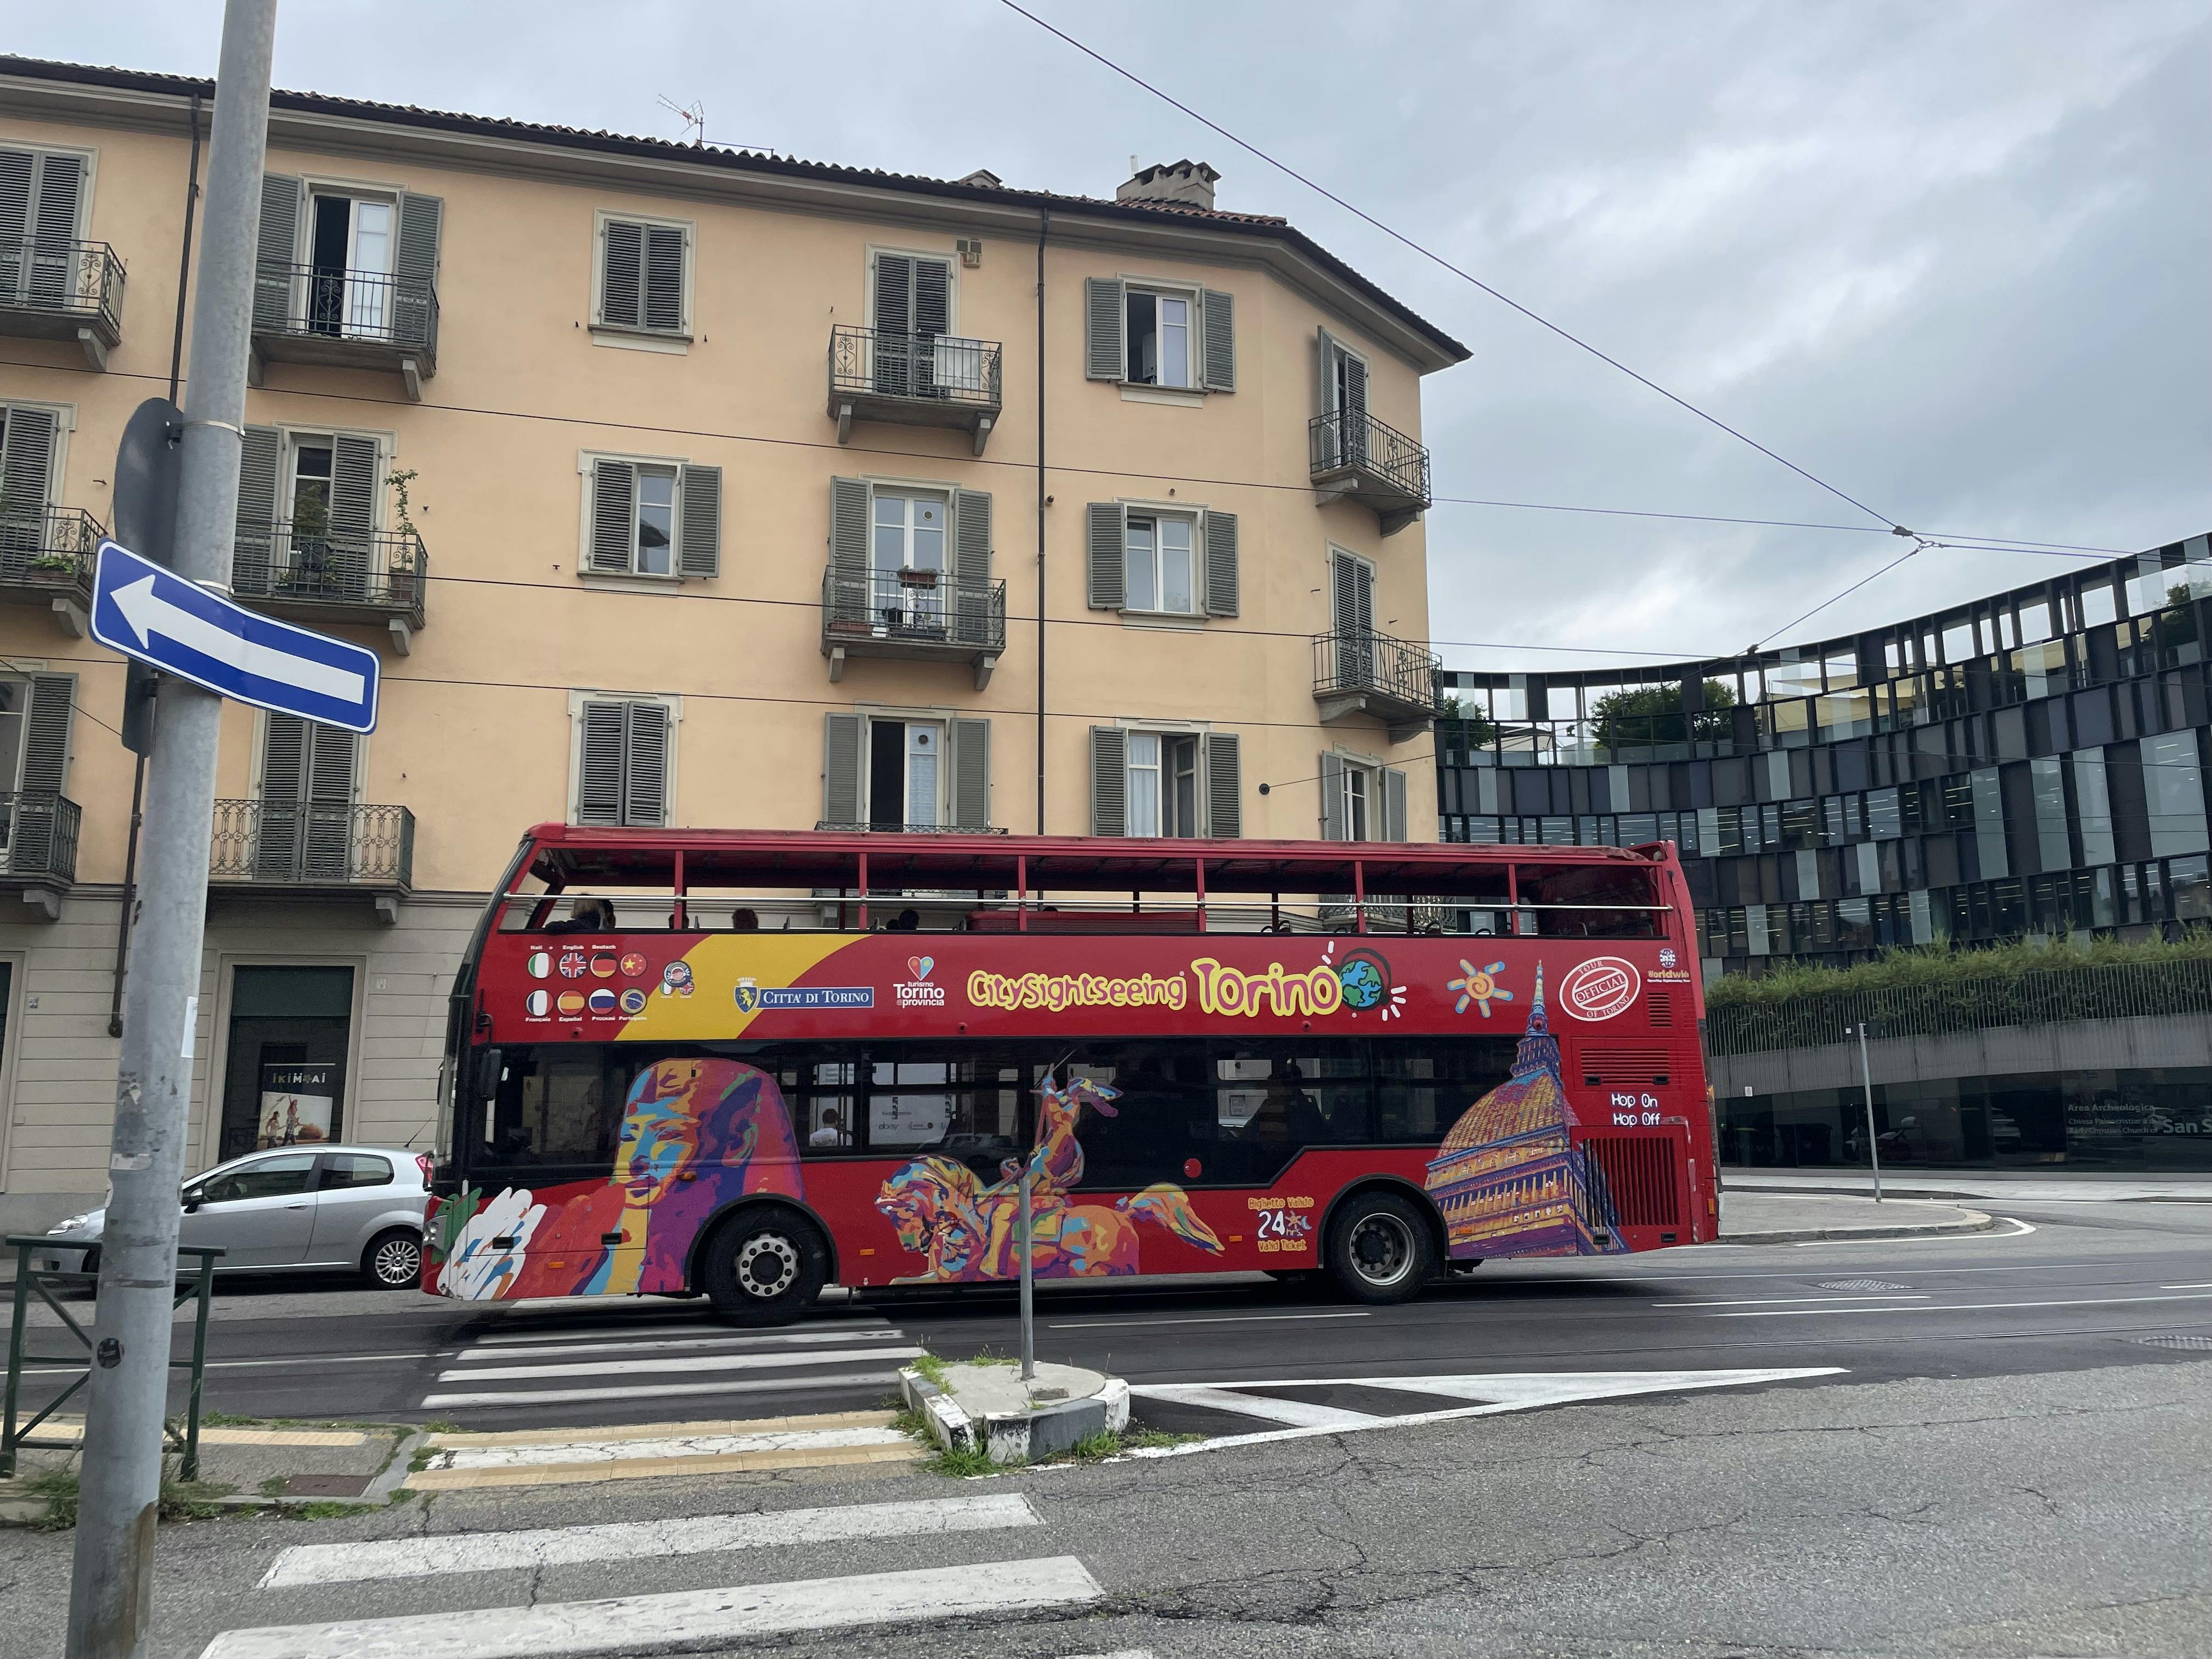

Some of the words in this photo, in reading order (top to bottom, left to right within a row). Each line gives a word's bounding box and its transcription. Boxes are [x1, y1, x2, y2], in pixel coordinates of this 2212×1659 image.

[1577, 960, 1604, 975] TOUR
[893, 984, 945, 999] Torino
[1191, 957, 1343, 1018] Torino
[1576, 975, 1626, 1002] OFFICIAL
[806, 993, 819, 1003] DI
[822, 990, 869, 1003] TORINO
[902, 999, 945, 1009] provincia
[1601, 995, 1630, 1016] TORINO
[1611, 1093, 1635, 1108] Hop
[1641, 1093, 1658, 1108] On
[2092, 1103, 2154, 1113] Archeologica
[1613, 1113, 1638, 1128] Hop
[1642, 1112, 1661, 1126] Off
[2163, 1119, 2198, 1133] San
[1258, 1210, 1285, 1238] 24
[1258, 1239, 1280, 1252] Valid
[1280, 1239, 1307, 1251] Ticket
